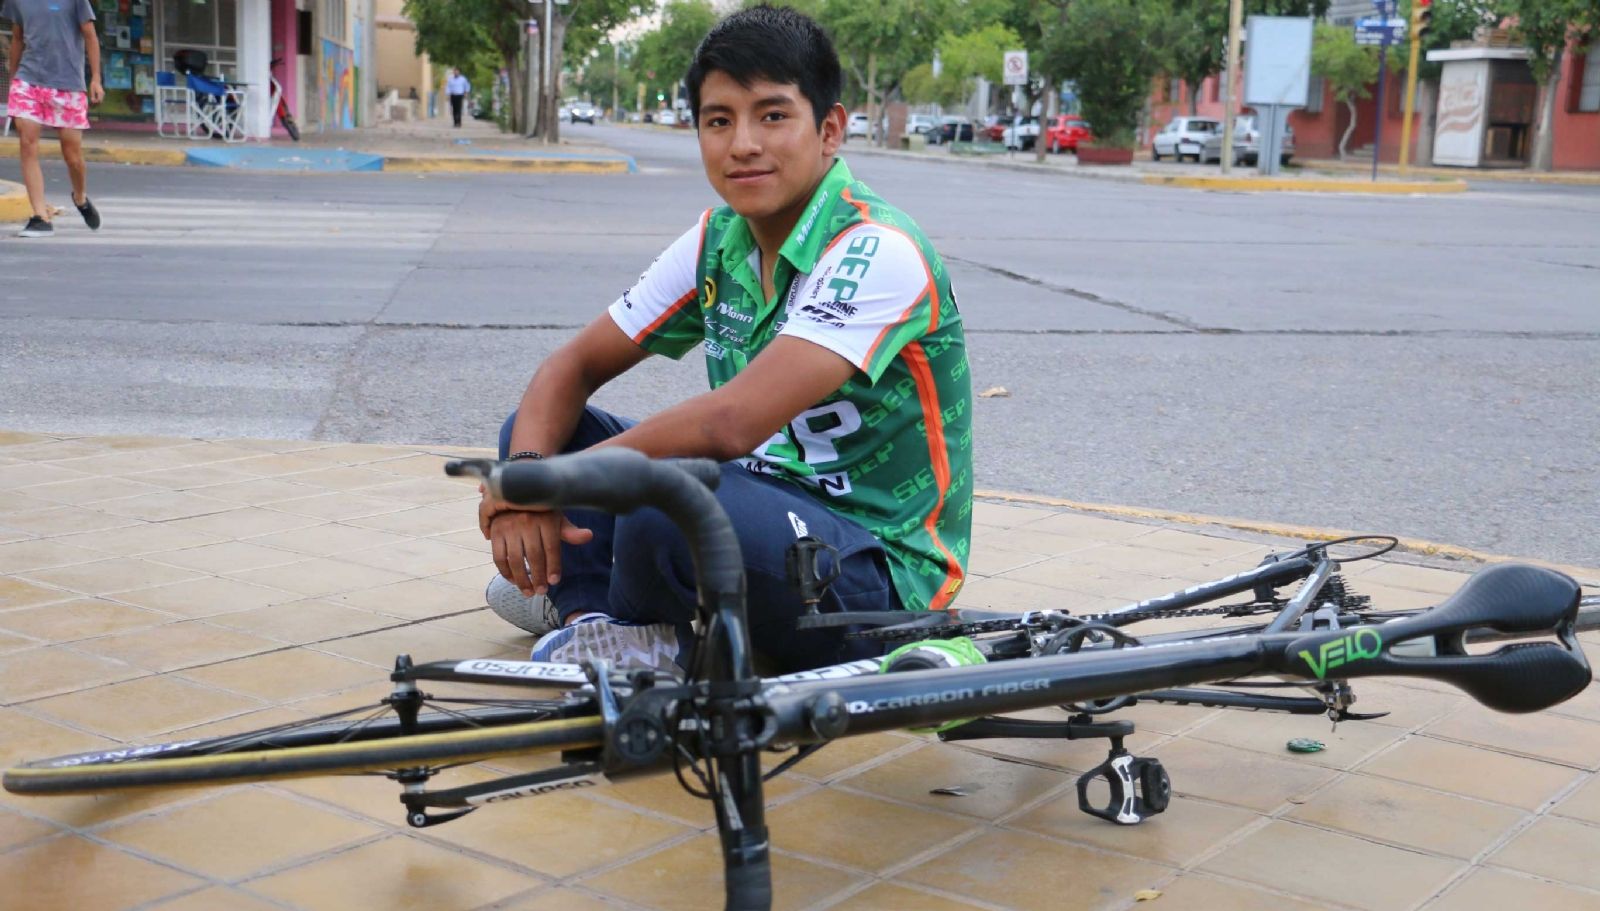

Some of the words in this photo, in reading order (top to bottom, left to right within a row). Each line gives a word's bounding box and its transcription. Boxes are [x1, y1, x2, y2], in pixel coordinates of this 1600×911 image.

[796, 189, 829, 247] Monton
[828, 236, 879, 301] SEP
[861, 377, 916, 428] SEP
[892, 464, 935, 504] SE
[1298, 627, 1383, 680] VELO
[981, 676, 1050, 696] FIBER
